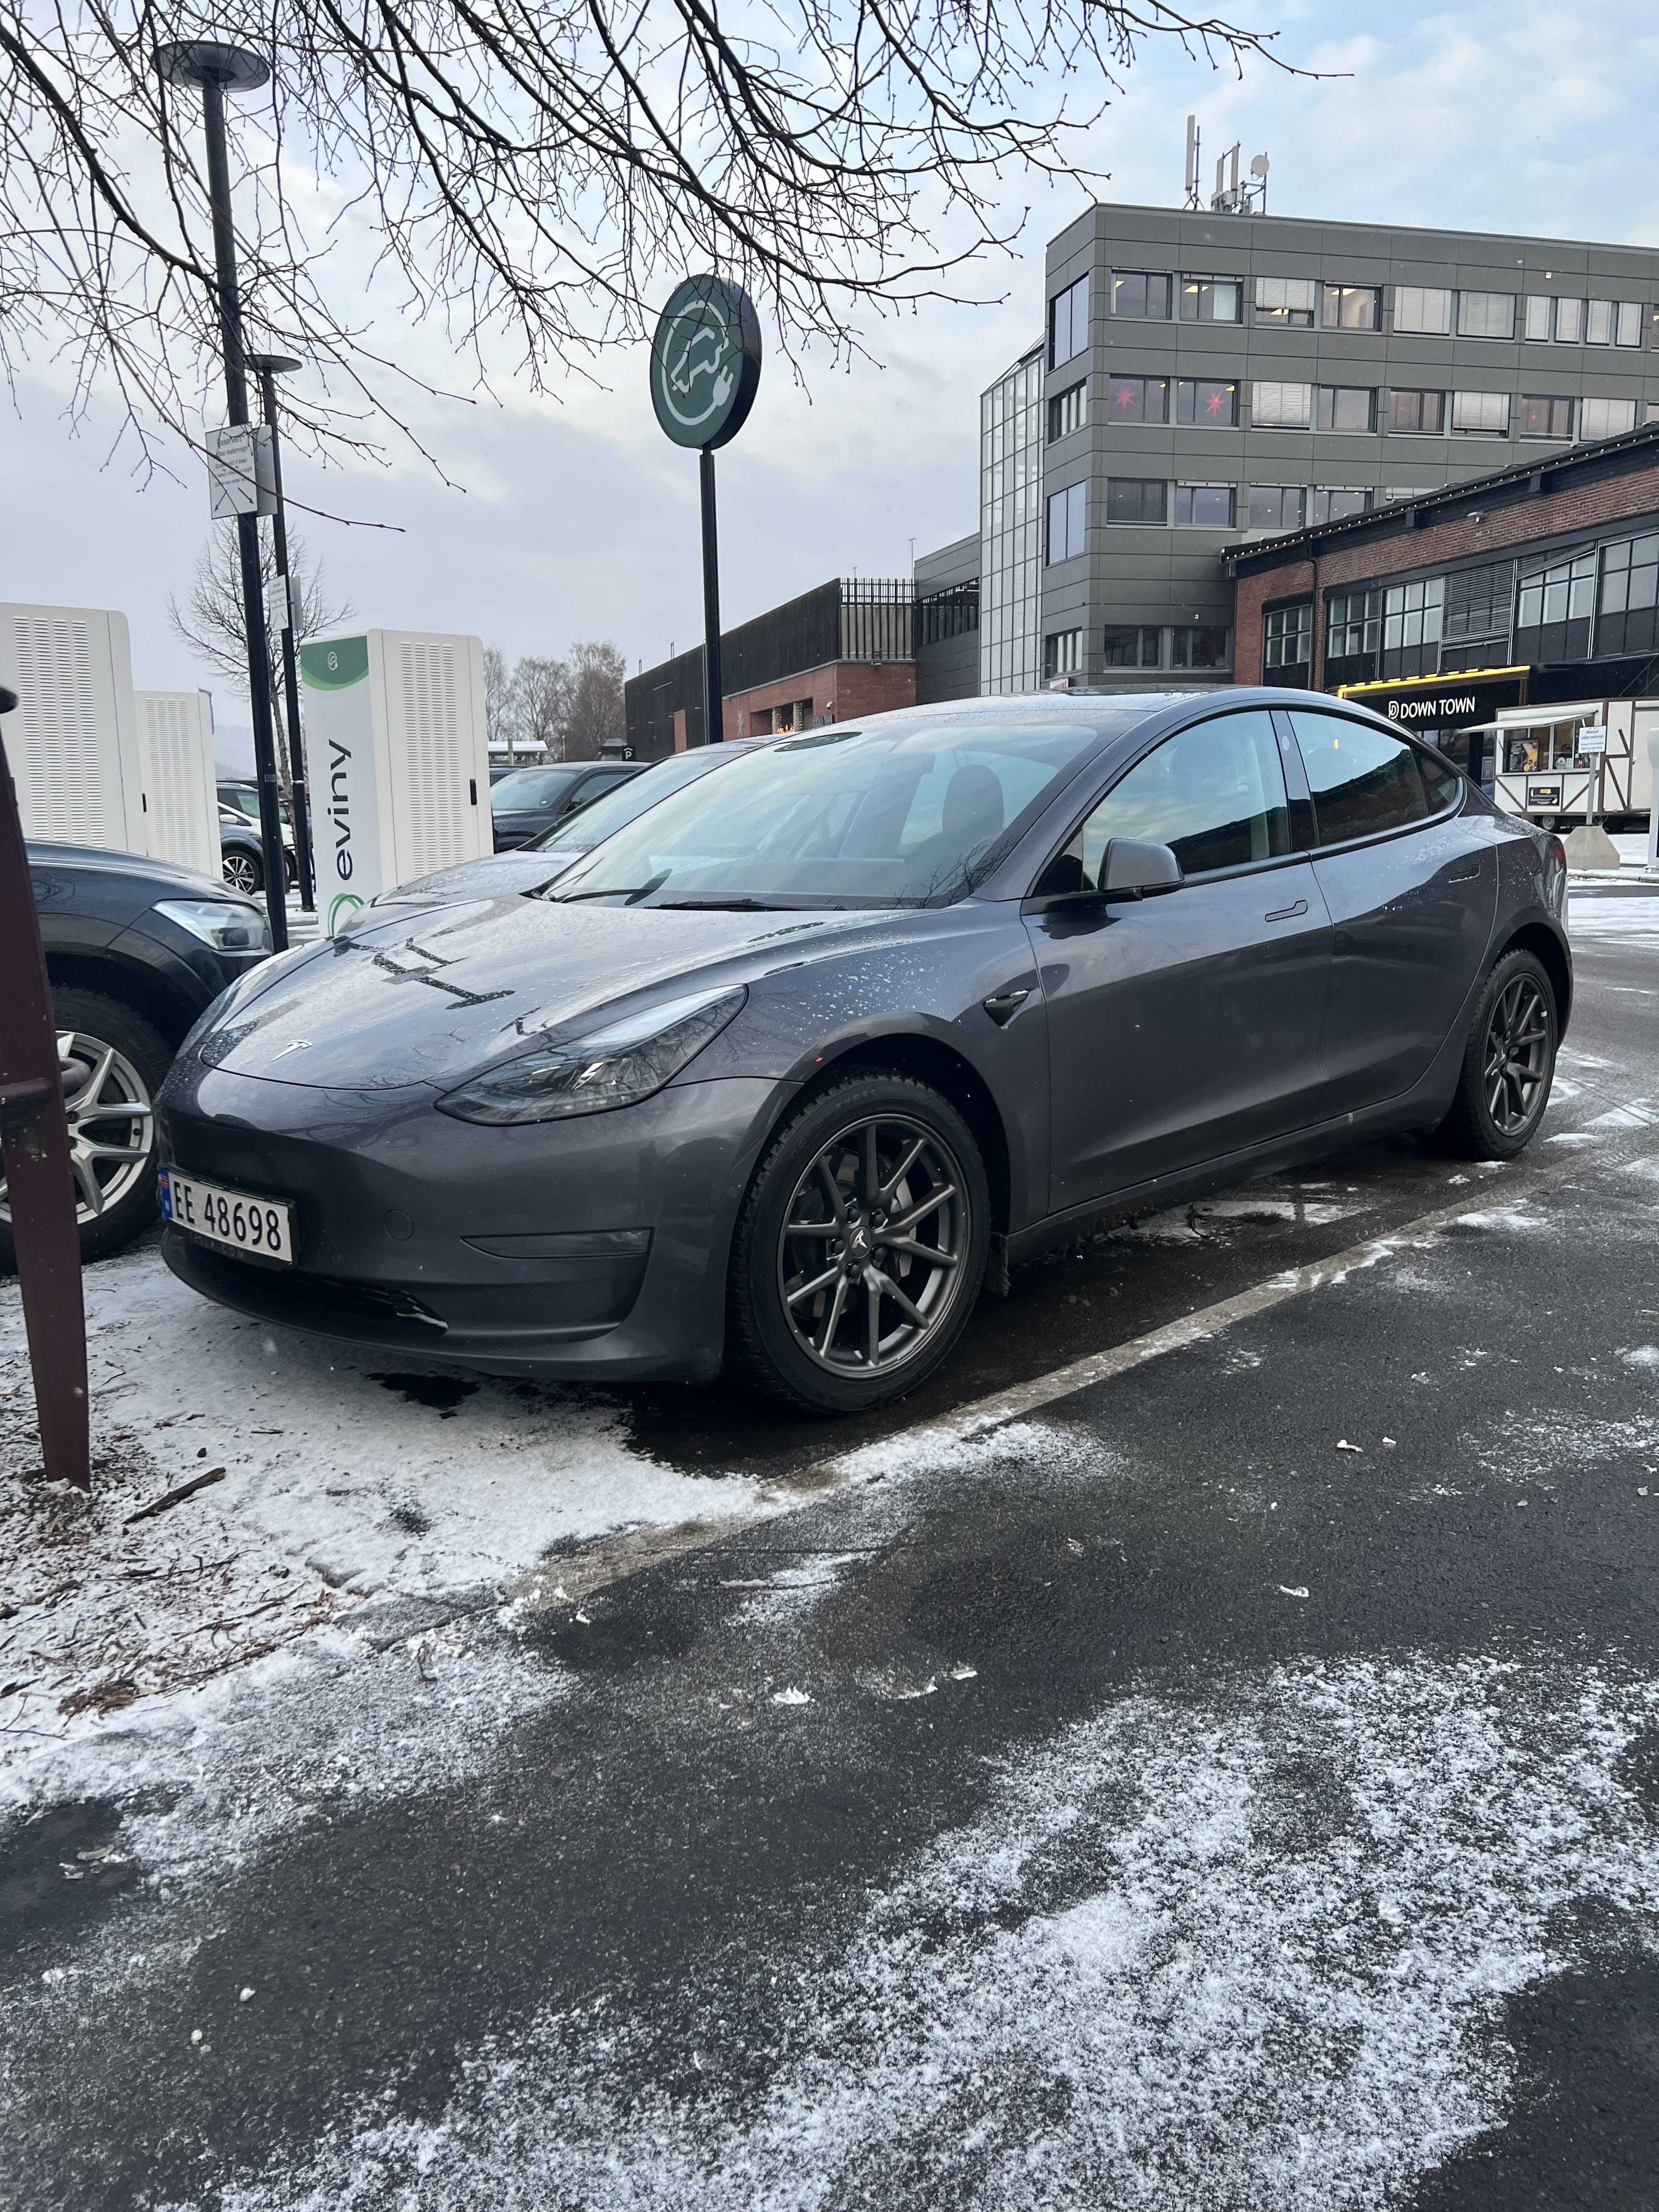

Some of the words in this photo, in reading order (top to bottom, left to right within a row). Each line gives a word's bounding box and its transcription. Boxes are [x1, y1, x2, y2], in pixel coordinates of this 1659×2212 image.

[1400, 700, 1436, 719] DOWN
[1439, 696, 1475, 715] TOWN
[625, 751, 632, 759] P
[328, 738, 353, 880] eviny
[173, 1180, 195, 1224] EE
[205, 1193, 281, 1250] 48698
